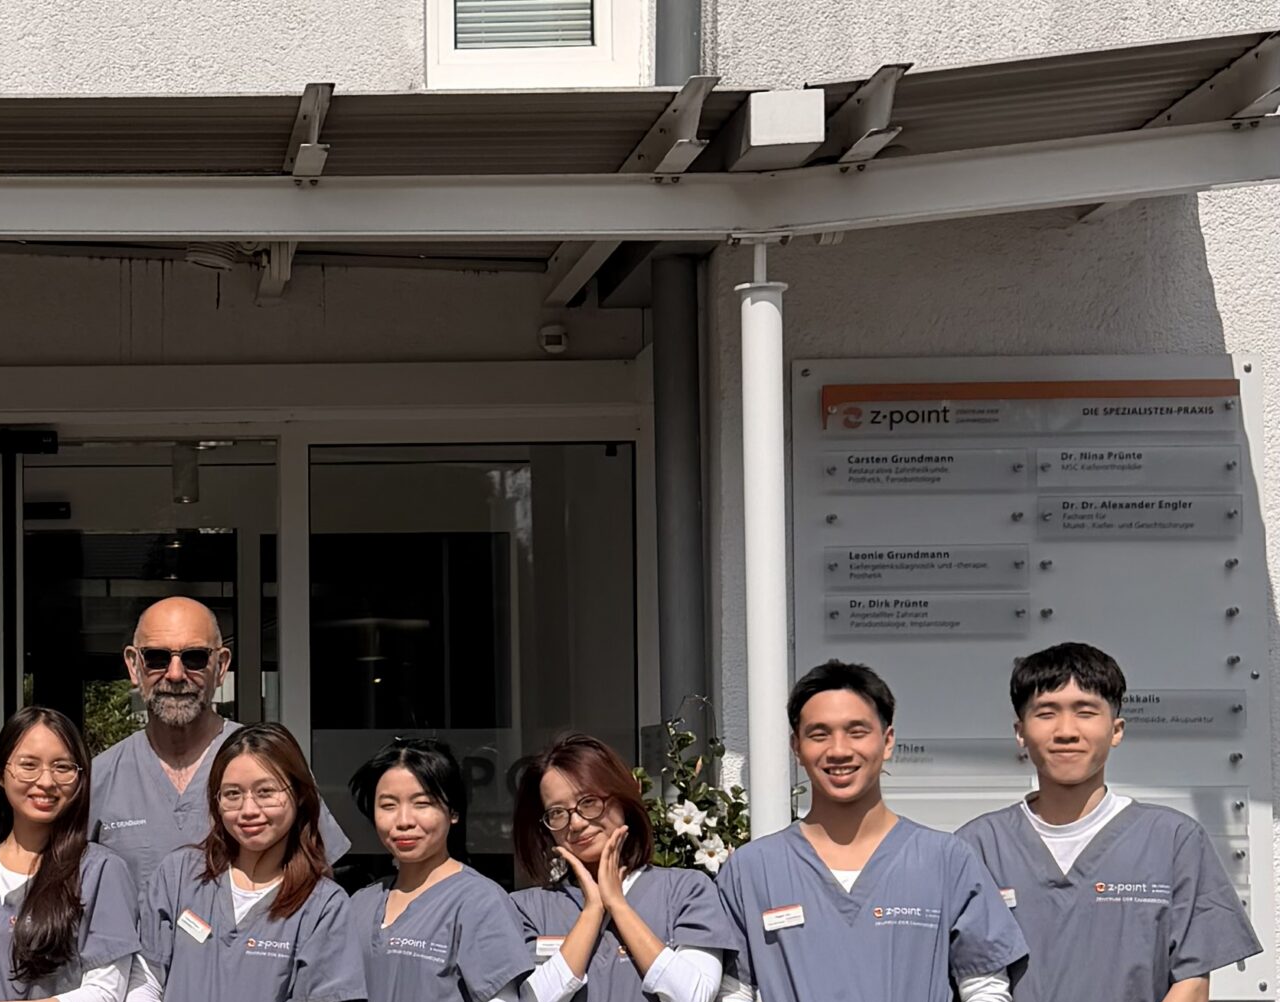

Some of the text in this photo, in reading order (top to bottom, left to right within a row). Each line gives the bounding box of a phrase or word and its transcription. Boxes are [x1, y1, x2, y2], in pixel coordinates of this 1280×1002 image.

[1082, 406, 1214, 416] DIE SPEZIALISTEN-PRAXIS
[848, 454, 954, 464] Carsten Grundmann
[1060, 451, 1143, 461] Dr. Nina Prünte
[1062, 500, 1193, 511] Dr. Dr. Alexander Engler
[849, 550, 950, 560] Leonie Grundmann
[850, 599, 929, 609] Dr. Dirk Prünte
[1122, 694, 1160, 704] okkalis
[897, 743, 925, 753] Thies
